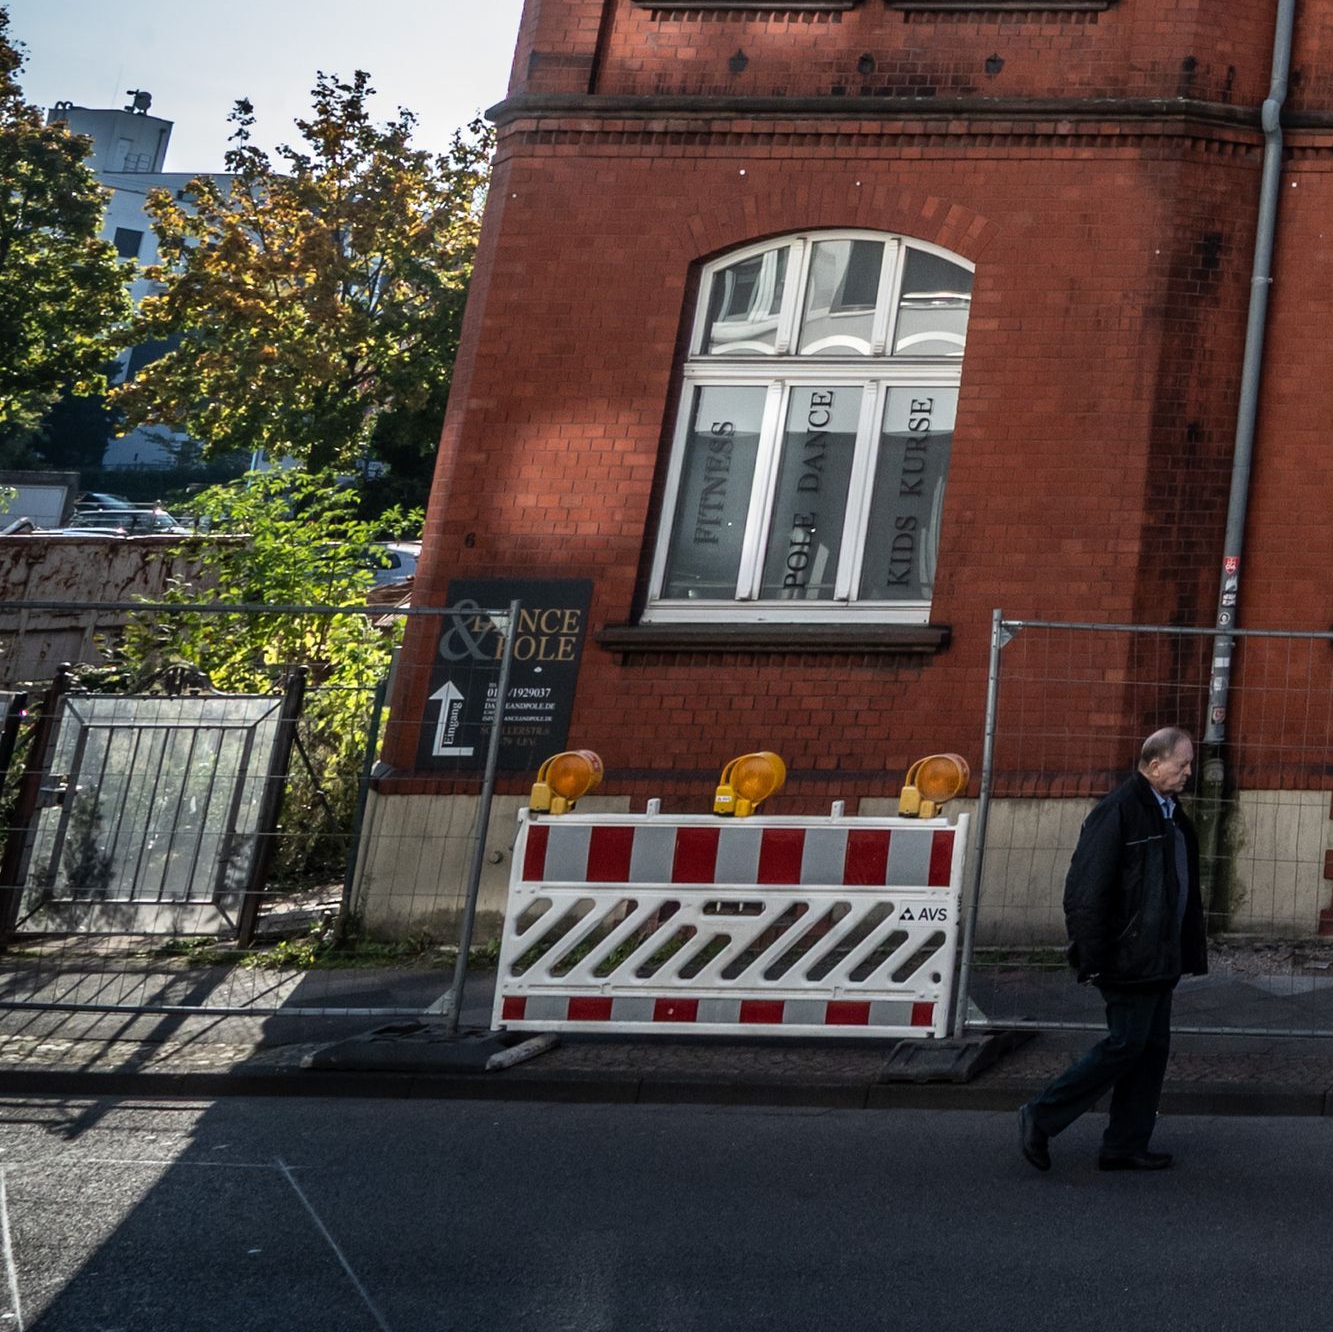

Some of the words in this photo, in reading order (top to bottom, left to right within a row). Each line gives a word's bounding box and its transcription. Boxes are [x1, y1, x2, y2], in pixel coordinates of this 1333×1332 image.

[797, 390, 834, 495] DANCE
[900, 397, 934, 497] KURSE
[694, 420, 736, 545] FITNESS
[464, 532, 476, 548] 6
[783, 512, 816, 591] POLE
[887, 515, 918, 589] KIDS
[444, 702, 462, 745] Eingang
[487, 688, 551, 698] 01/1929037
[918, 908, 948, 921] AVS
